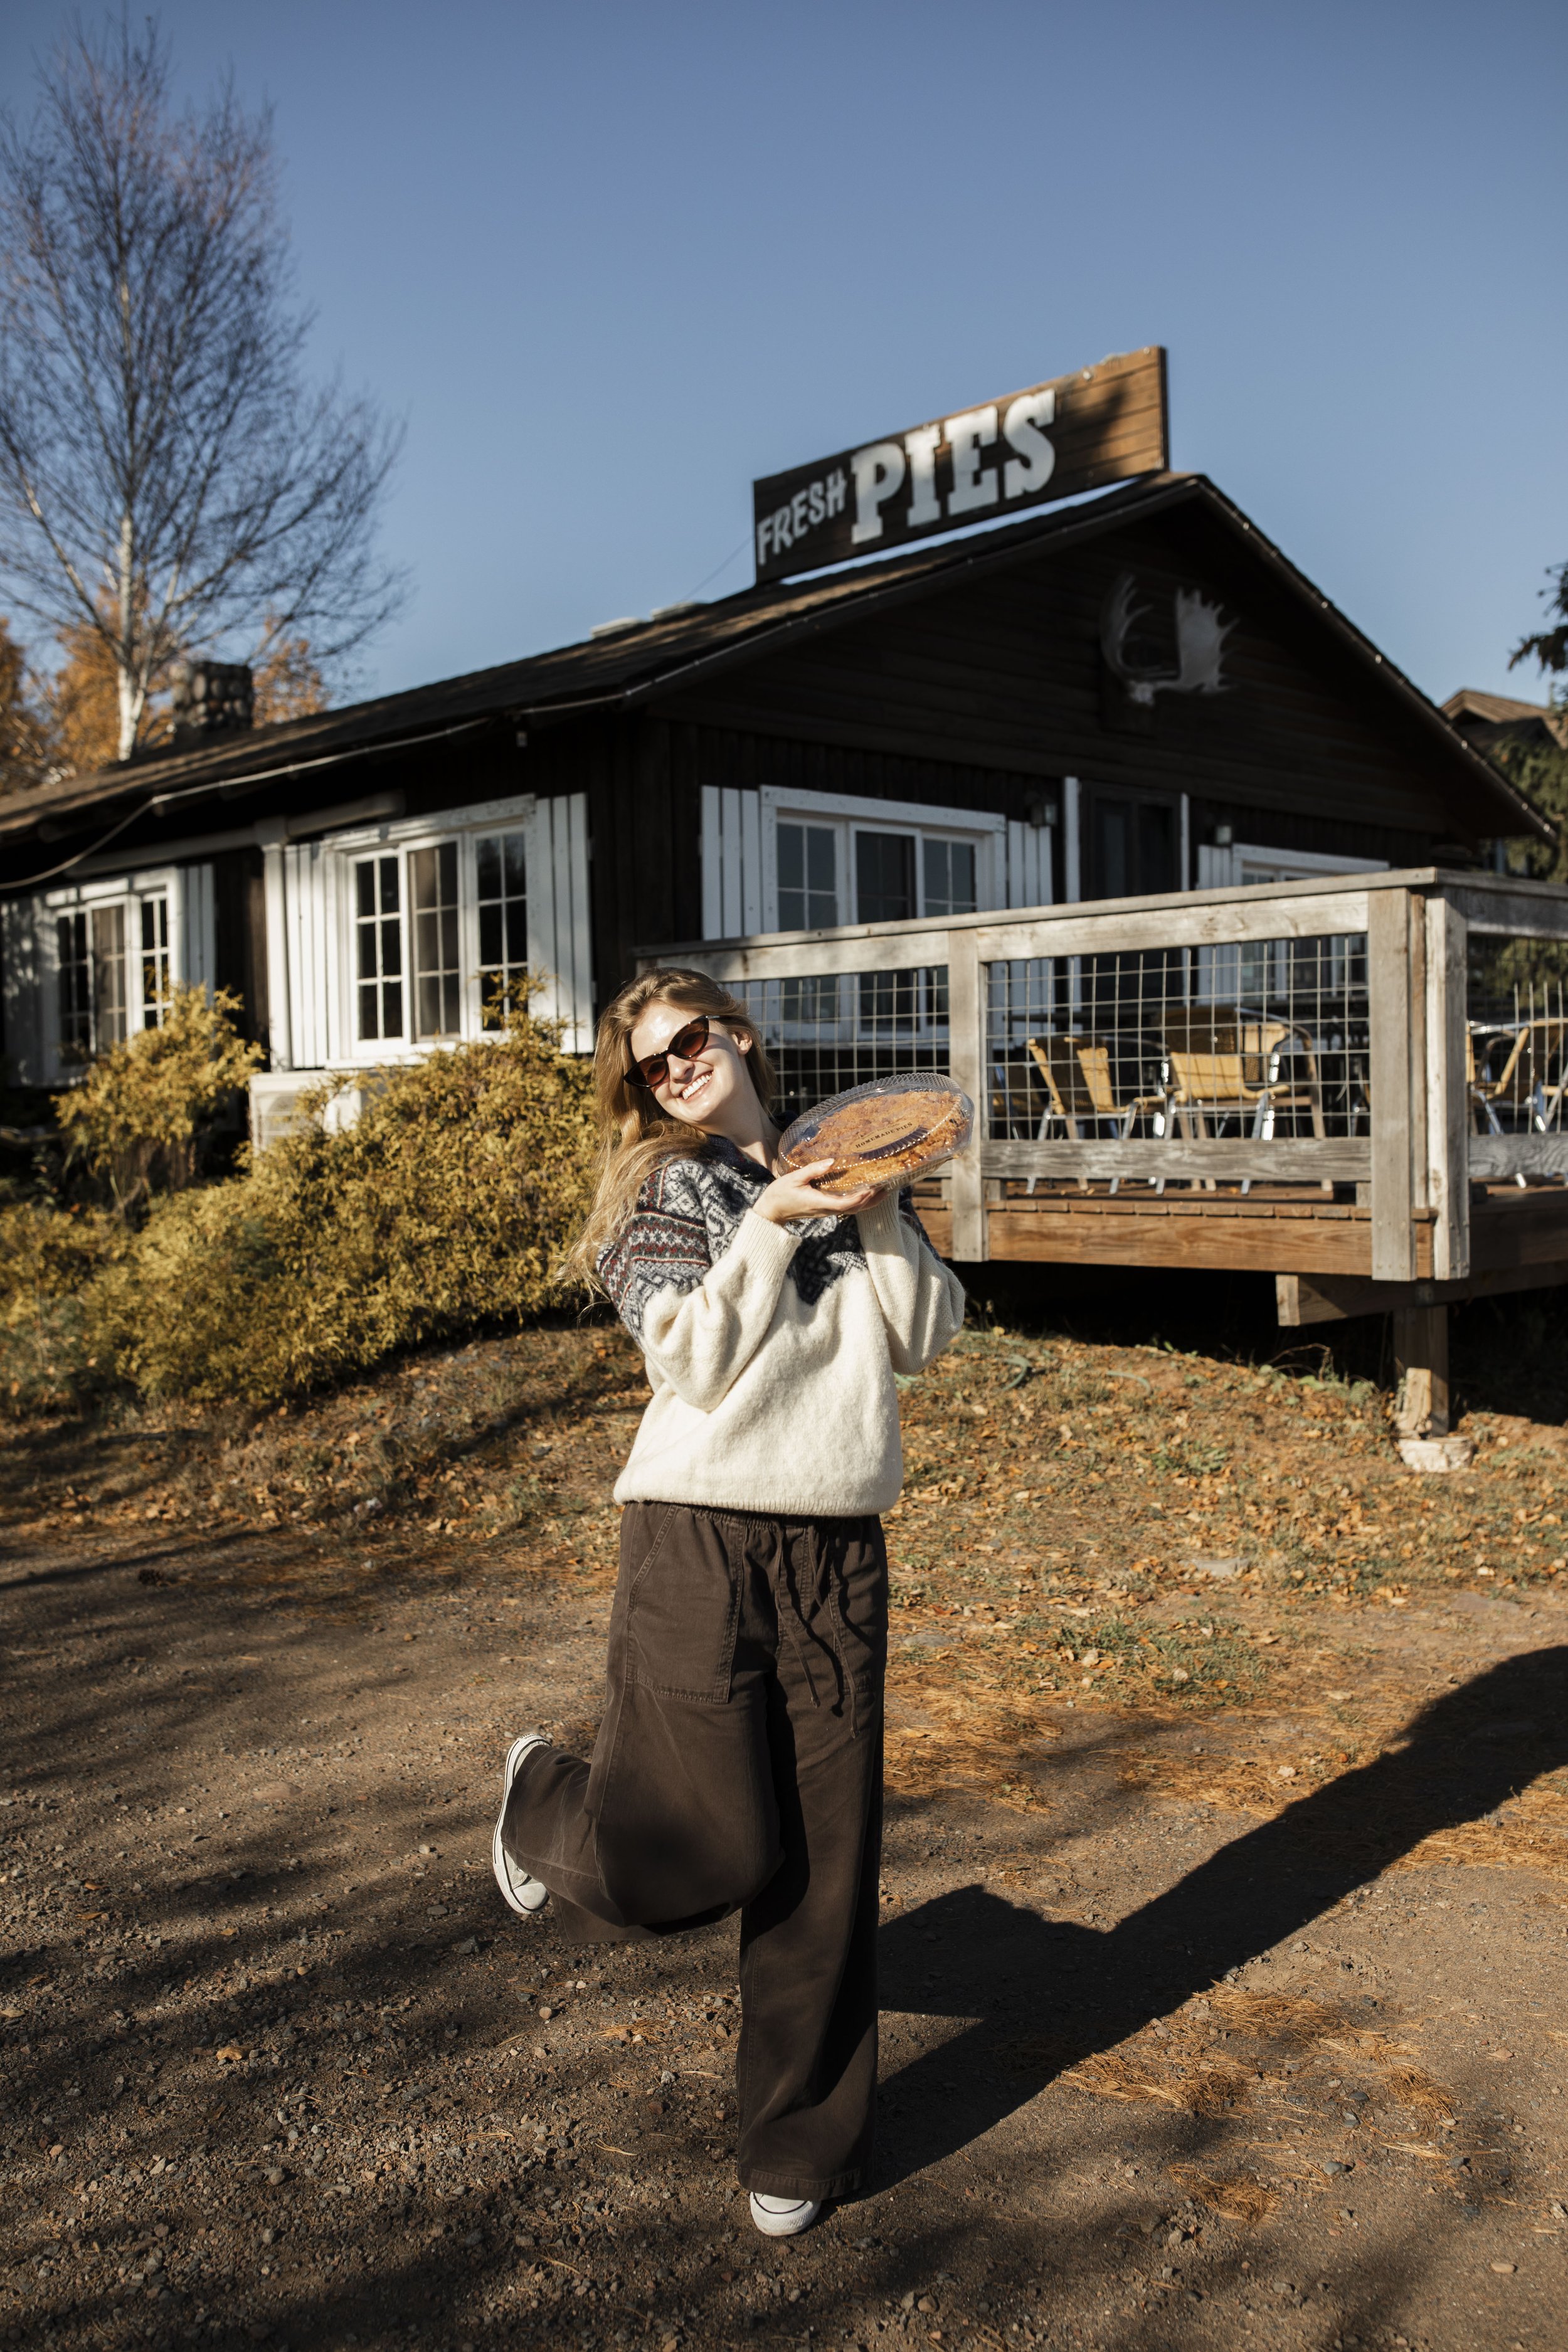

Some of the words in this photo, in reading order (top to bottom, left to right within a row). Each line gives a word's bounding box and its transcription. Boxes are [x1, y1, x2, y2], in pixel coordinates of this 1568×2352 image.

[756, 467, 847, 566] FRESH
[850, 388, 1056, 545] PIES
[855, 1129, 896, 1148] HOMEMADE
[896, 1121, 913, 1131] PIES
